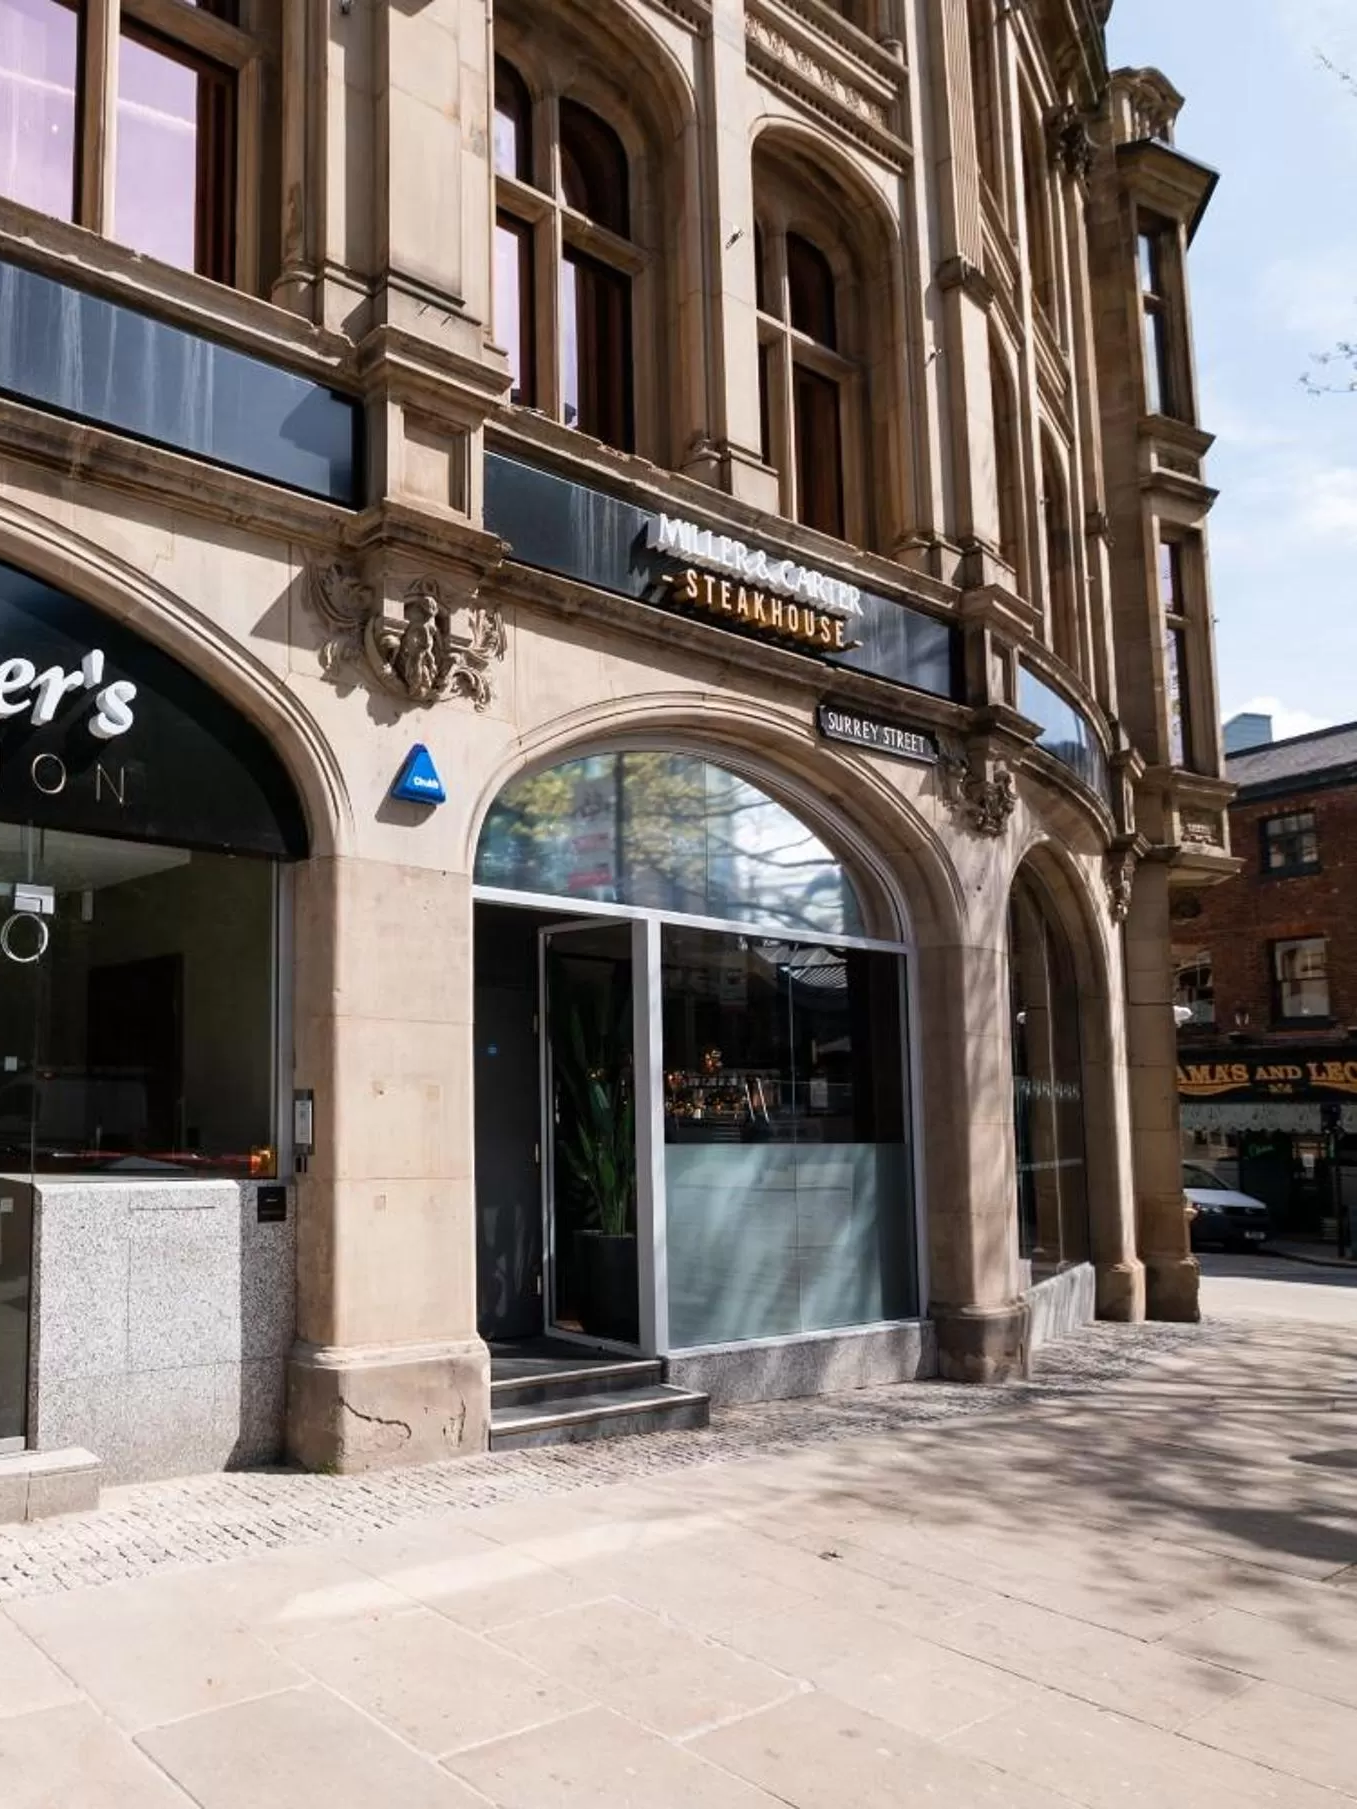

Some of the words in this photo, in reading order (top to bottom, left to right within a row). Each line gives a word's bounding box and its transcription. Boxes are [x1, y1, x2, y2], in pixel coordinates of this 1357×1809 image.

[654, 512, 749, 574] MILLER
[750, 548, 777, 584] &
[778, 559, 865, 617] CARTER
[686, 569, 845, 647] STEAKHOUSE
[828, 712, 879, 741] SURREY
[883, 726, 925, 753] STREET
[1255, 1065, 1303, 1081] AND
